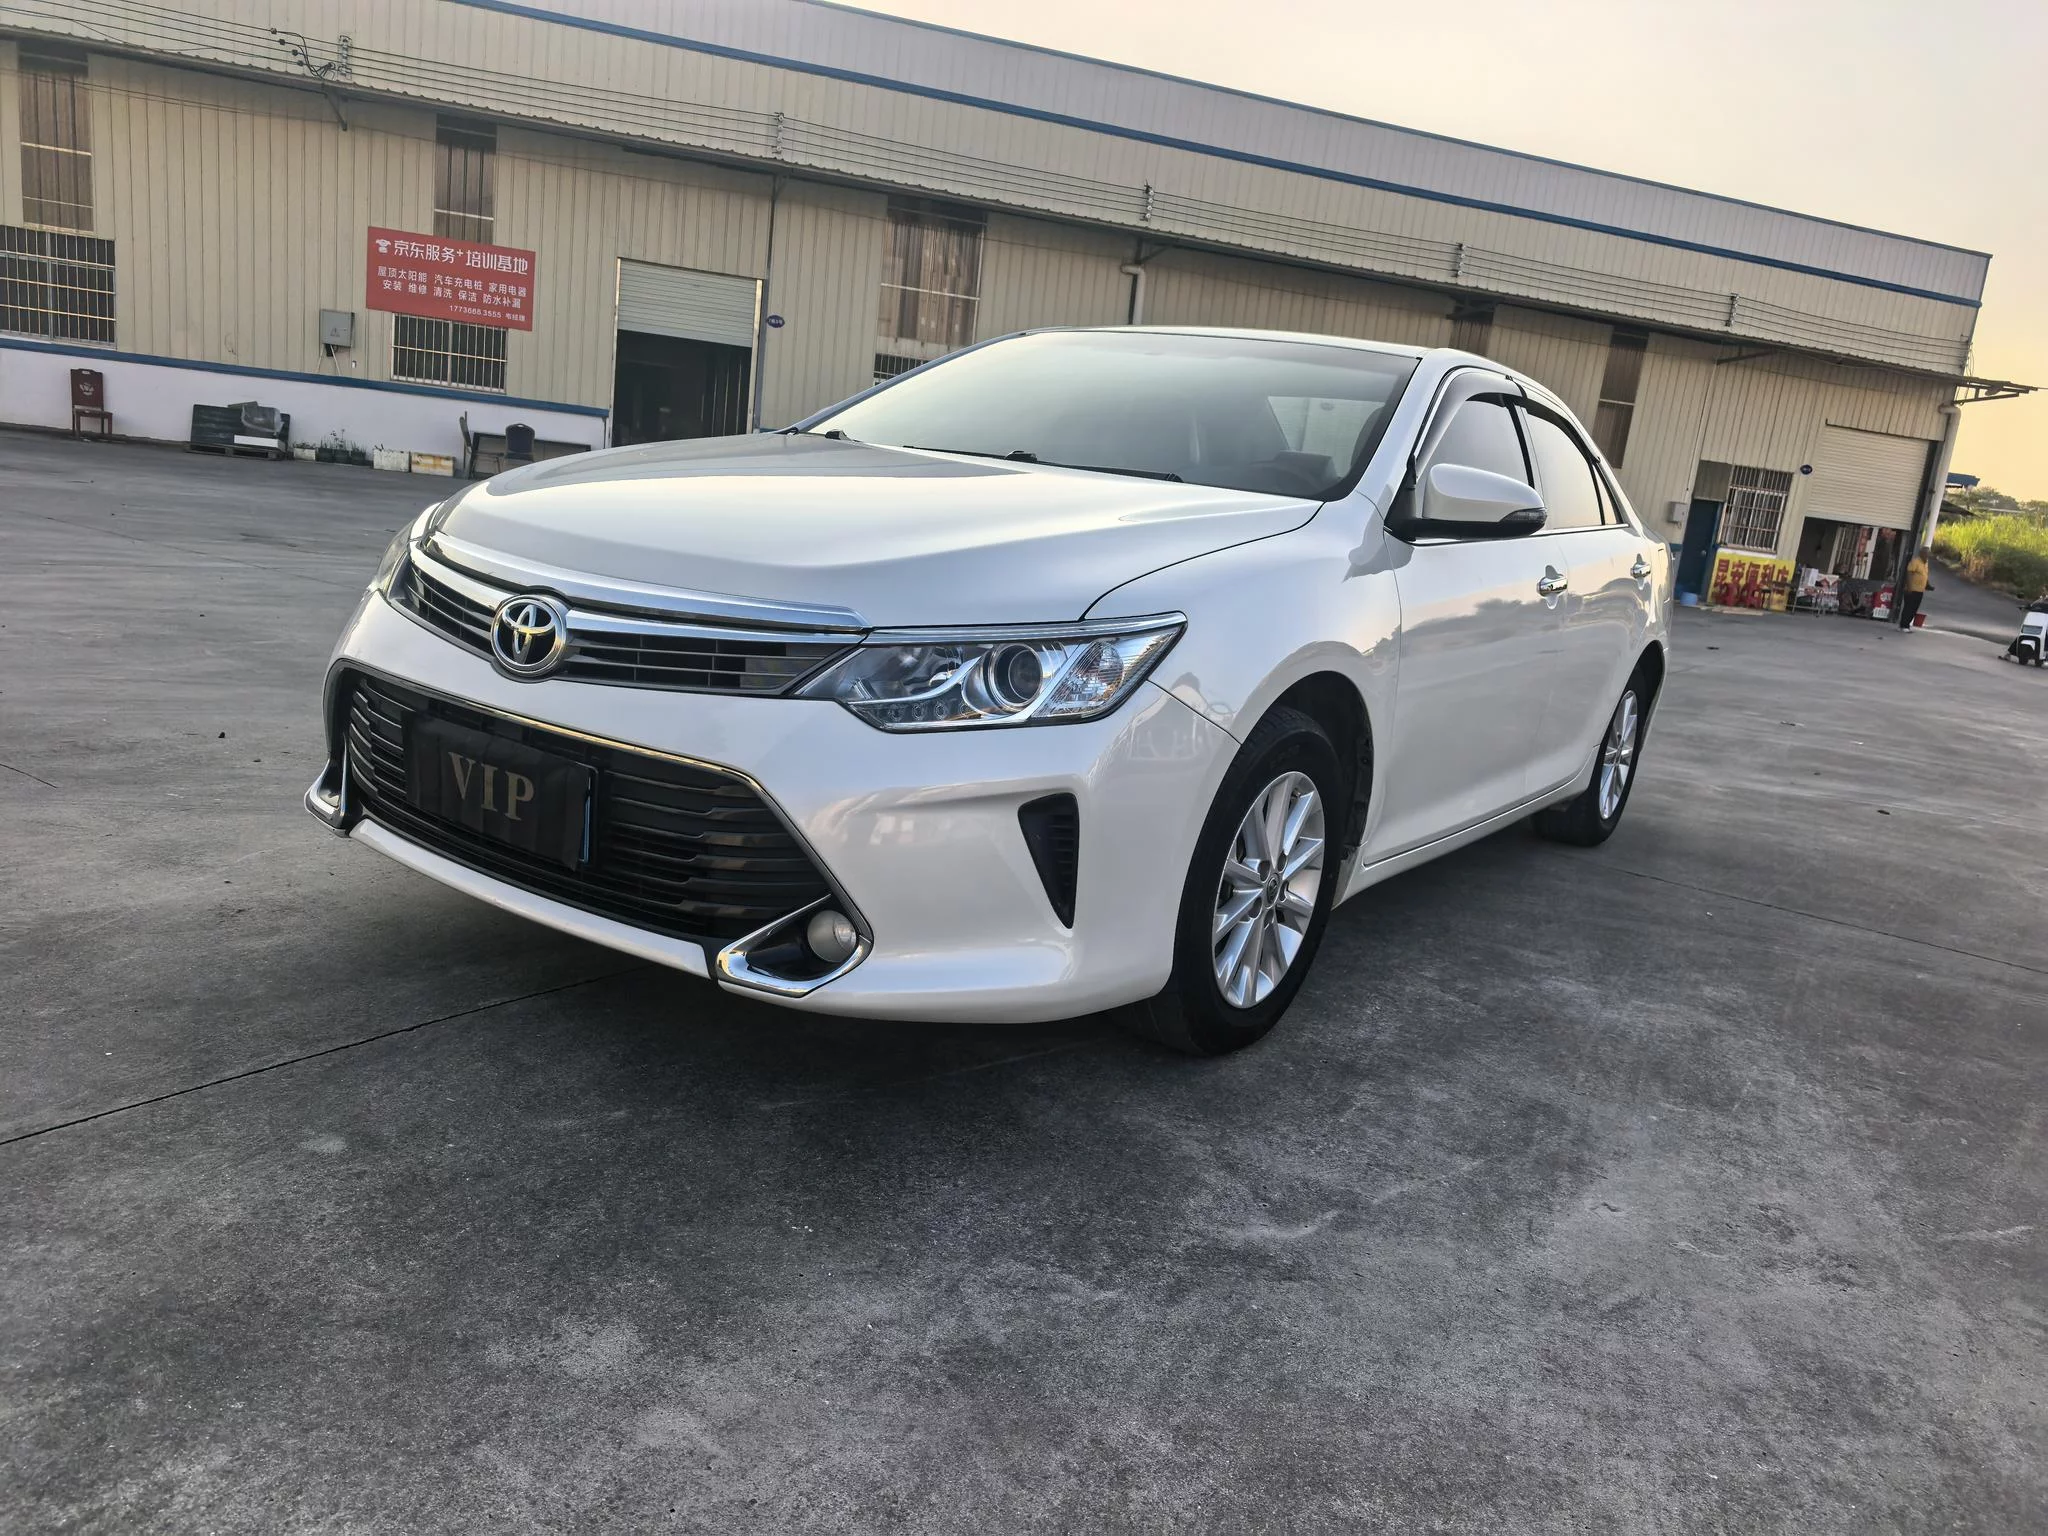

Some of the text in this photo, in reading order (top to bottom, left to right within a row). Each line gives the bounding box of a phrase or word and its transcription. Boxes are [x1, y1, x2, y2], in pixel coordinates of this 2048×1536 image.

[378, 266, 527, 297] 屋顶太阳能 汽车充电桩 家用电器
[383, 280, 520, 308] 安装 维修 清洗 保洁 防水补漏
[448, 751, 535, 820] VIP
